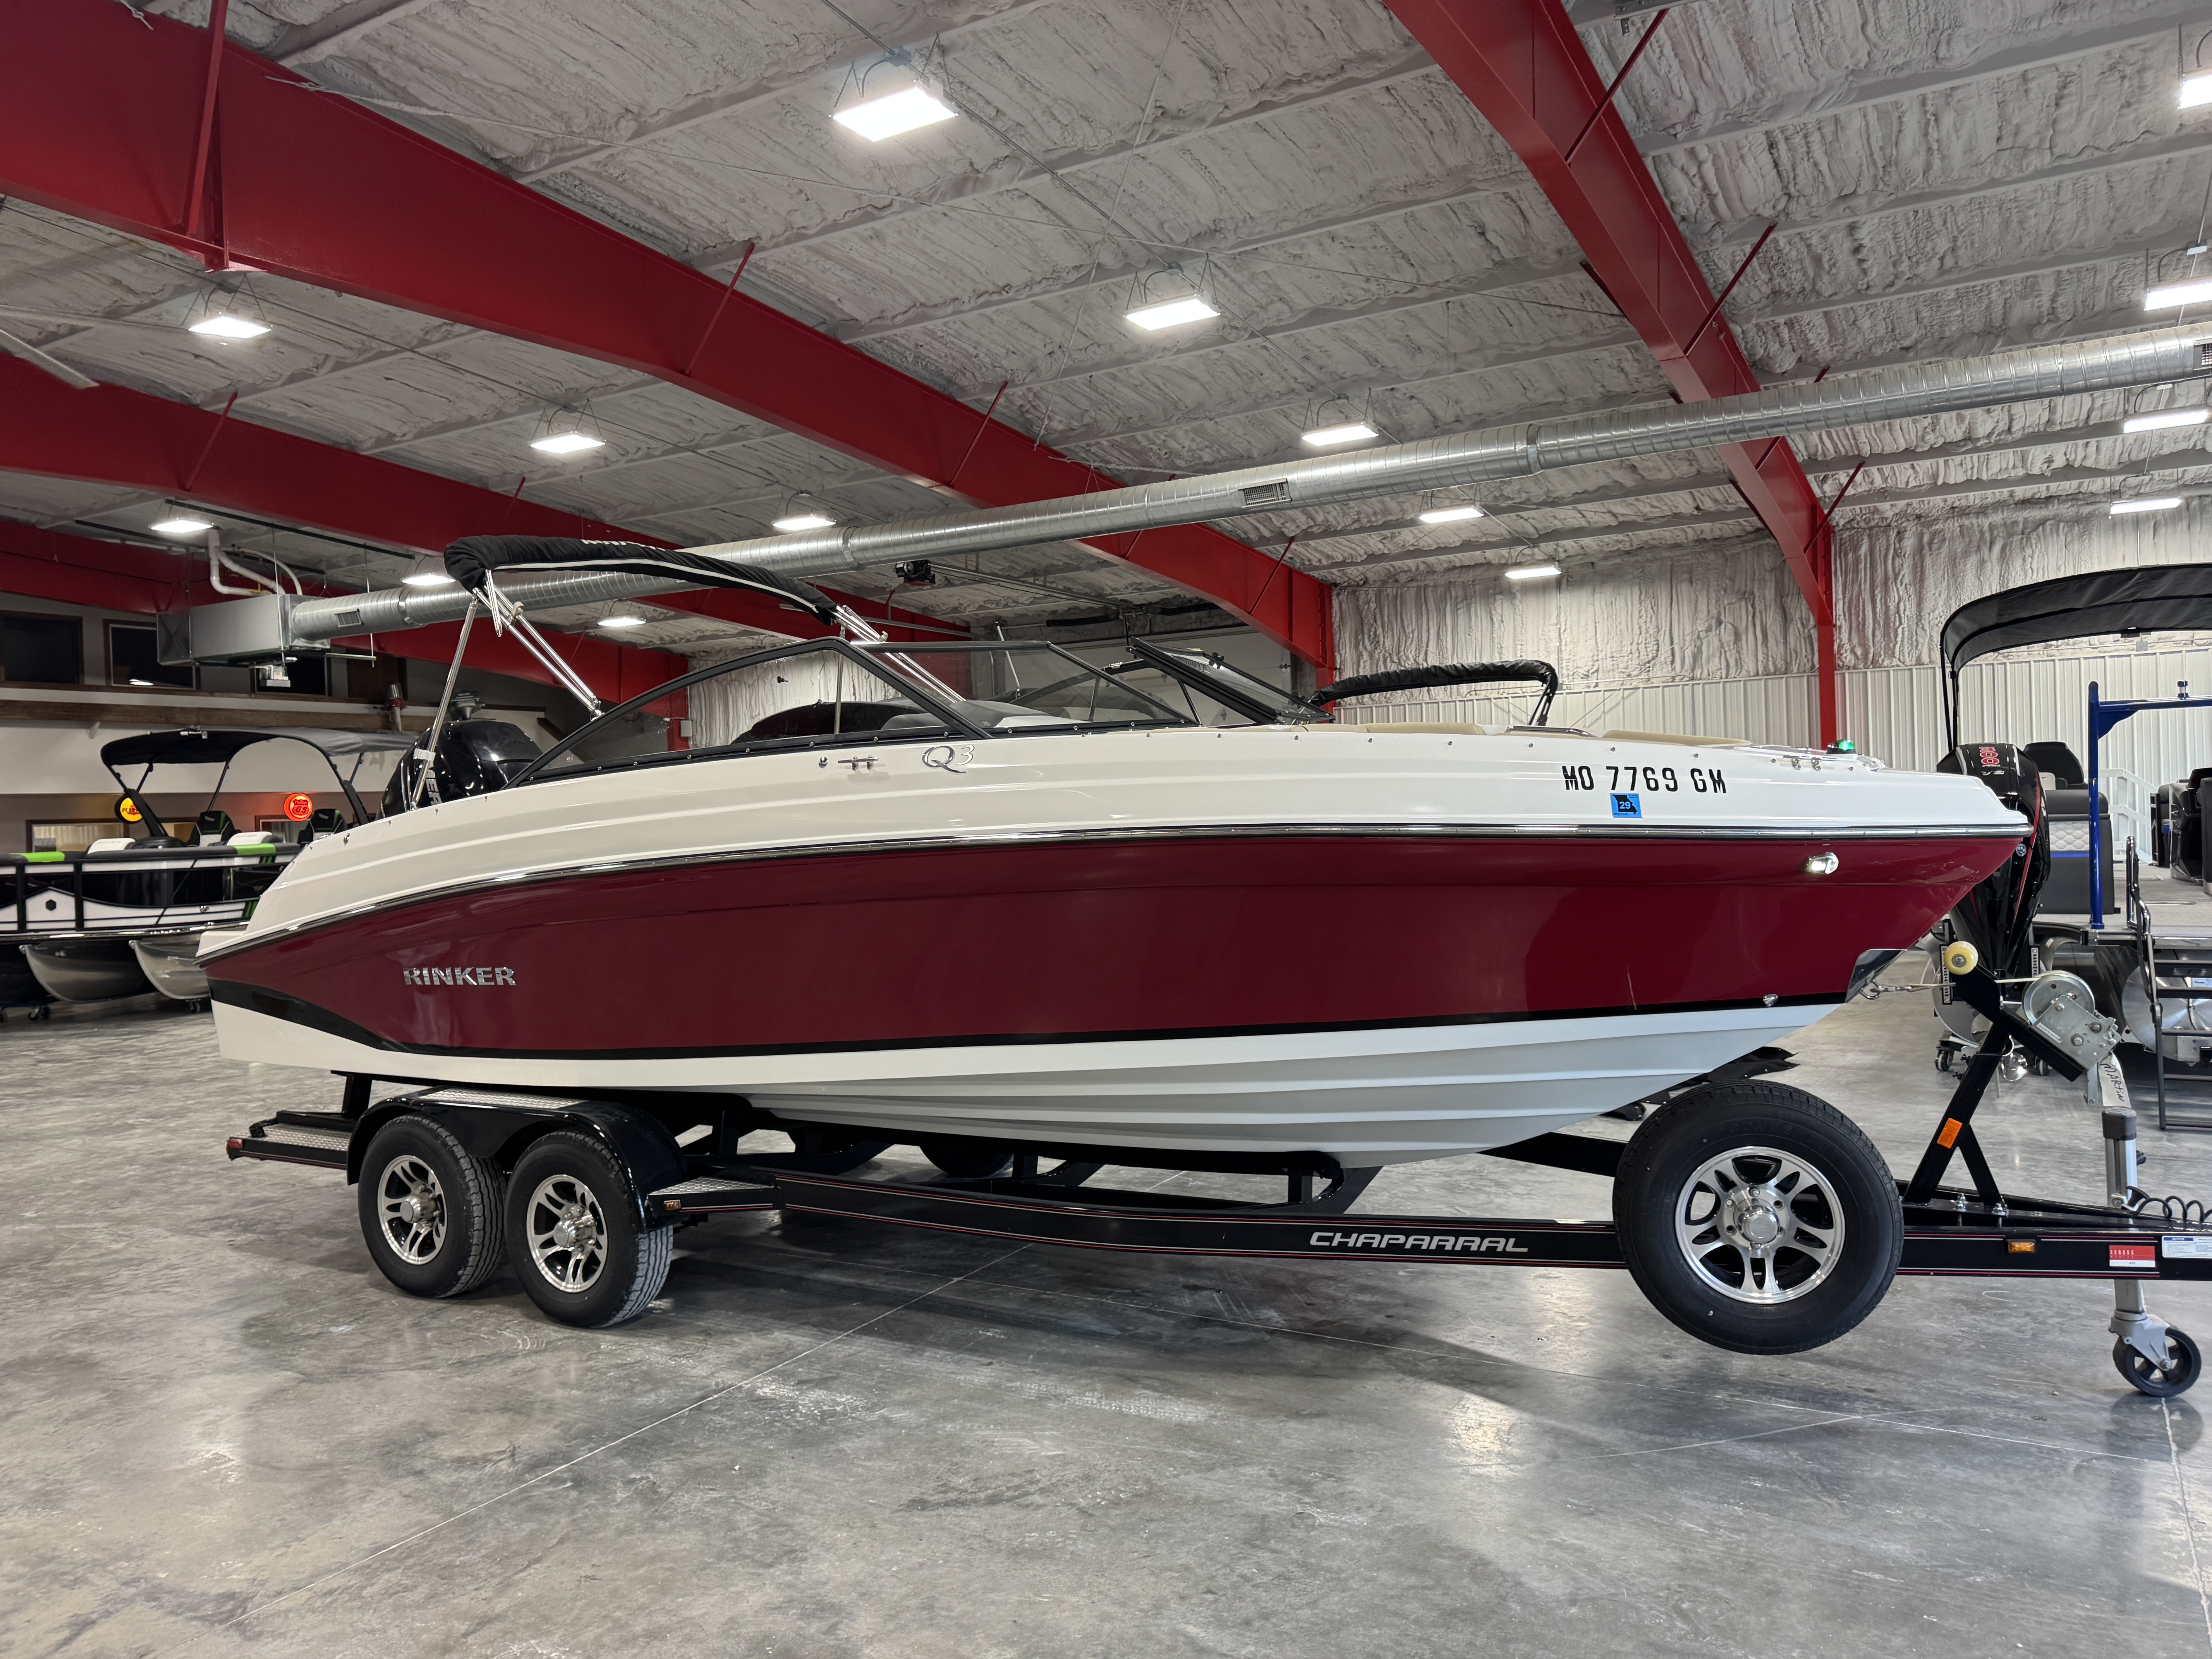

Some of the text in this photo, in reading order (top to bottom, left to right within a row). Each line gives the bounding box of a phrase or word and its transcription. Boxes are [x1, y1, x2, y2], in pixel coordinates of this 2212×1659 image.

[1562, 766, 1727, 793] MO 7769 GM
[404, 967, 517, 986] RINKER
[1310, 1232, 1528, 1252] CHAPARRAL
